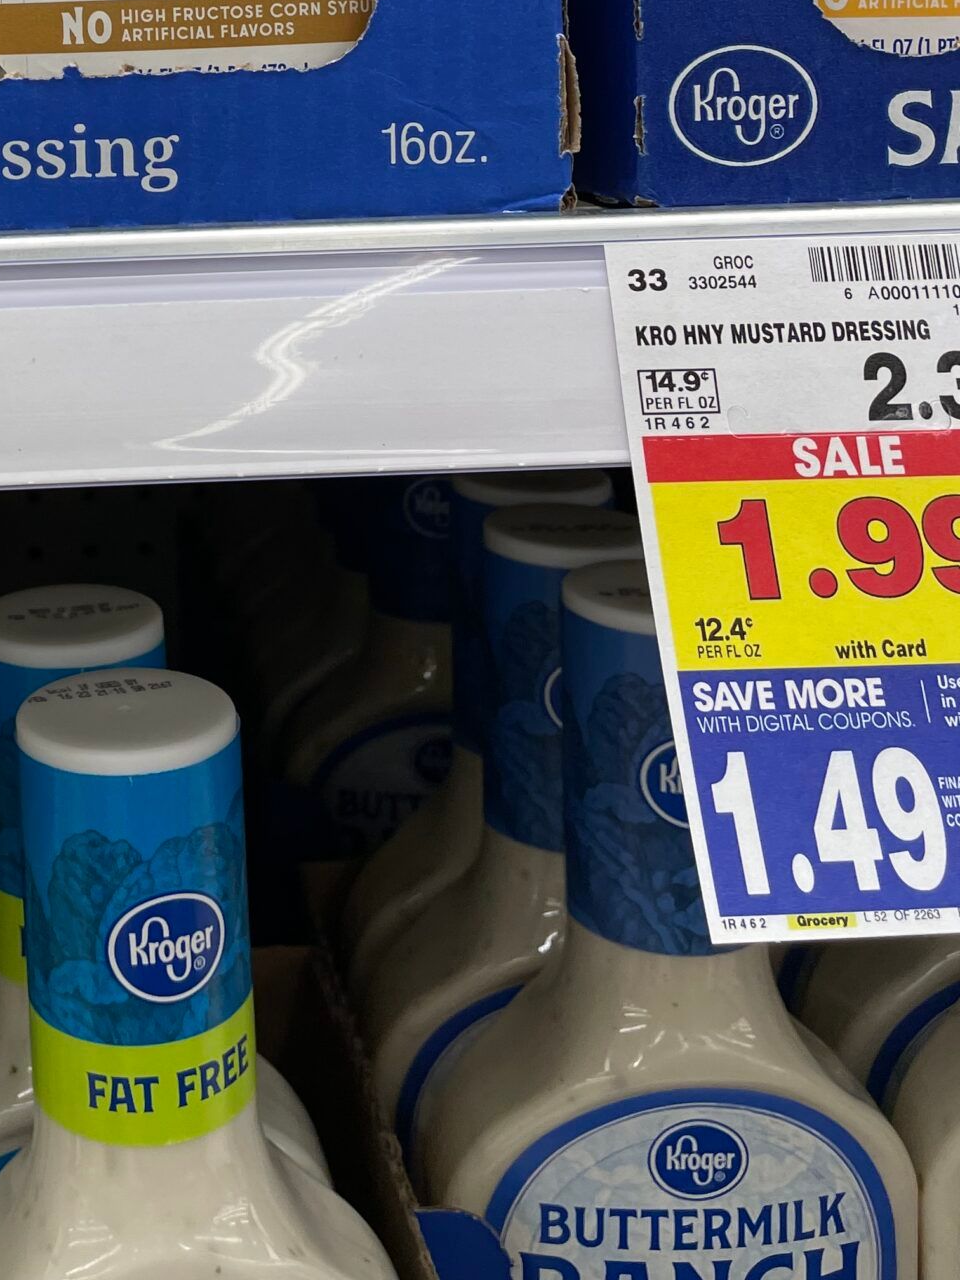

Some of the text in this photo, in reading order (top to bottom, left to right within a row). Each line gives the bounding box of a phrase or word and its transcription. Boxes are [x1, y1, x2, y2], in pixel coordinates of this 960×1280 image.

[121, 0, 374, 24] HIGH FRUCTOSE CORN SYRU
[61, 6, 113, 45] NO
[121, 21, 295, 42] ARTIFICIAL FLAVORS
[692, 67, 800, 147] Kroger
[380, 121, 489, 168] 16oz.
[712, 255, 754, 270] GROC
[627, 268, 669, 292] 33
[688, 275, 757, 291] 3302544
[843, 288, 853, 301] 6
[635, 319, 931, 347] KRO HNY MUSTARD DRESSING
[645, 395, 717, 411] PER FL OZ
[792, 435, 906, 478] SALE
[697, 643, 762, 659] PER FL OZ
[834, 638, 927, 660] with Card
[692, 677, 886, 712] SAVE MORE
[941, 693, 956, 709] in
[696, 711, 916, 734] WITH DIGITAL COUPONS.
[710, 746, 948, 896] 1.49
[796, 914, 849, 929] Grocery
[863, 908, 941, 923] L 52 OF 2263
[128, 915, 215, 982] Kroger
[86, 1034, 248, 1115] FAT FREE
[666, 1135, 736, 1186] Kroger
[538, 1191, 847, 1251] BUTTERMILK
